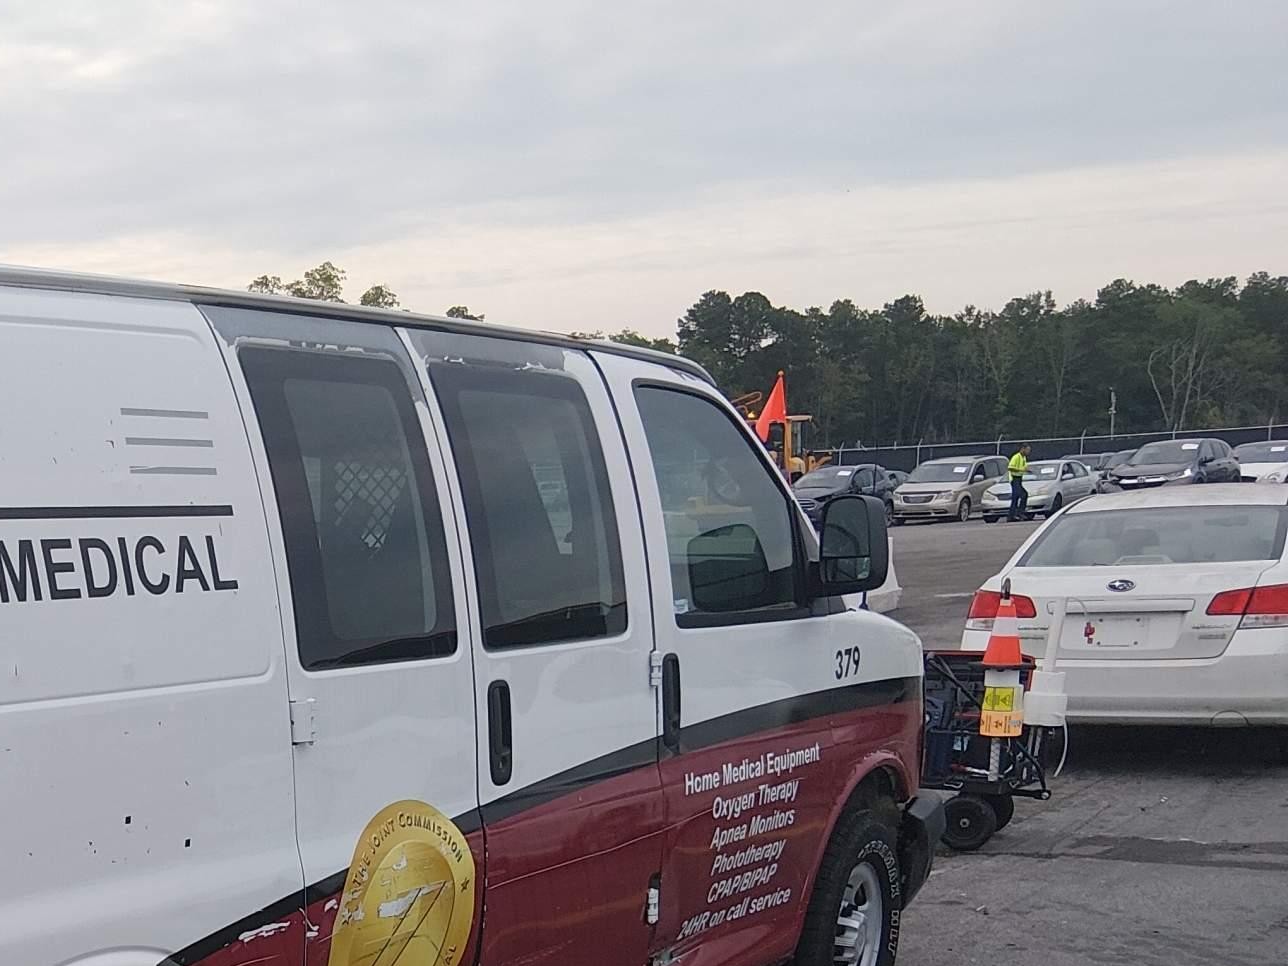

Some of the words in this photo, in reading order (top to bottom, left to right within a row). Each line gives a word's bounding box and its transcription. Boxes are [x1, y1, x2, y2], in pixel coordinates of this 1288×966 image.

[834, 645, 861, 681] 379
[685, 771, 720, 796] Home
[722, 754, 765, 786] Medical
[766, 741, 820, 777] Equipment
[712, 792, 755, 820] Oxygen
[758, 780, 799, 806] Therapy
[371, 818, 396, 855] JOINT
[397, 812, 464, 864] COMMISSION
[709, 826, 747, 852] Apnea
[749, 809, 796, 838] Monitors
[710, 838, 787, 877] Phototherapy
[676, 910, 711, 941] 24HR
[709, 909, 726, 928] on
[726, 896, 751, 921] call
[748, 886, 792, 914] service
